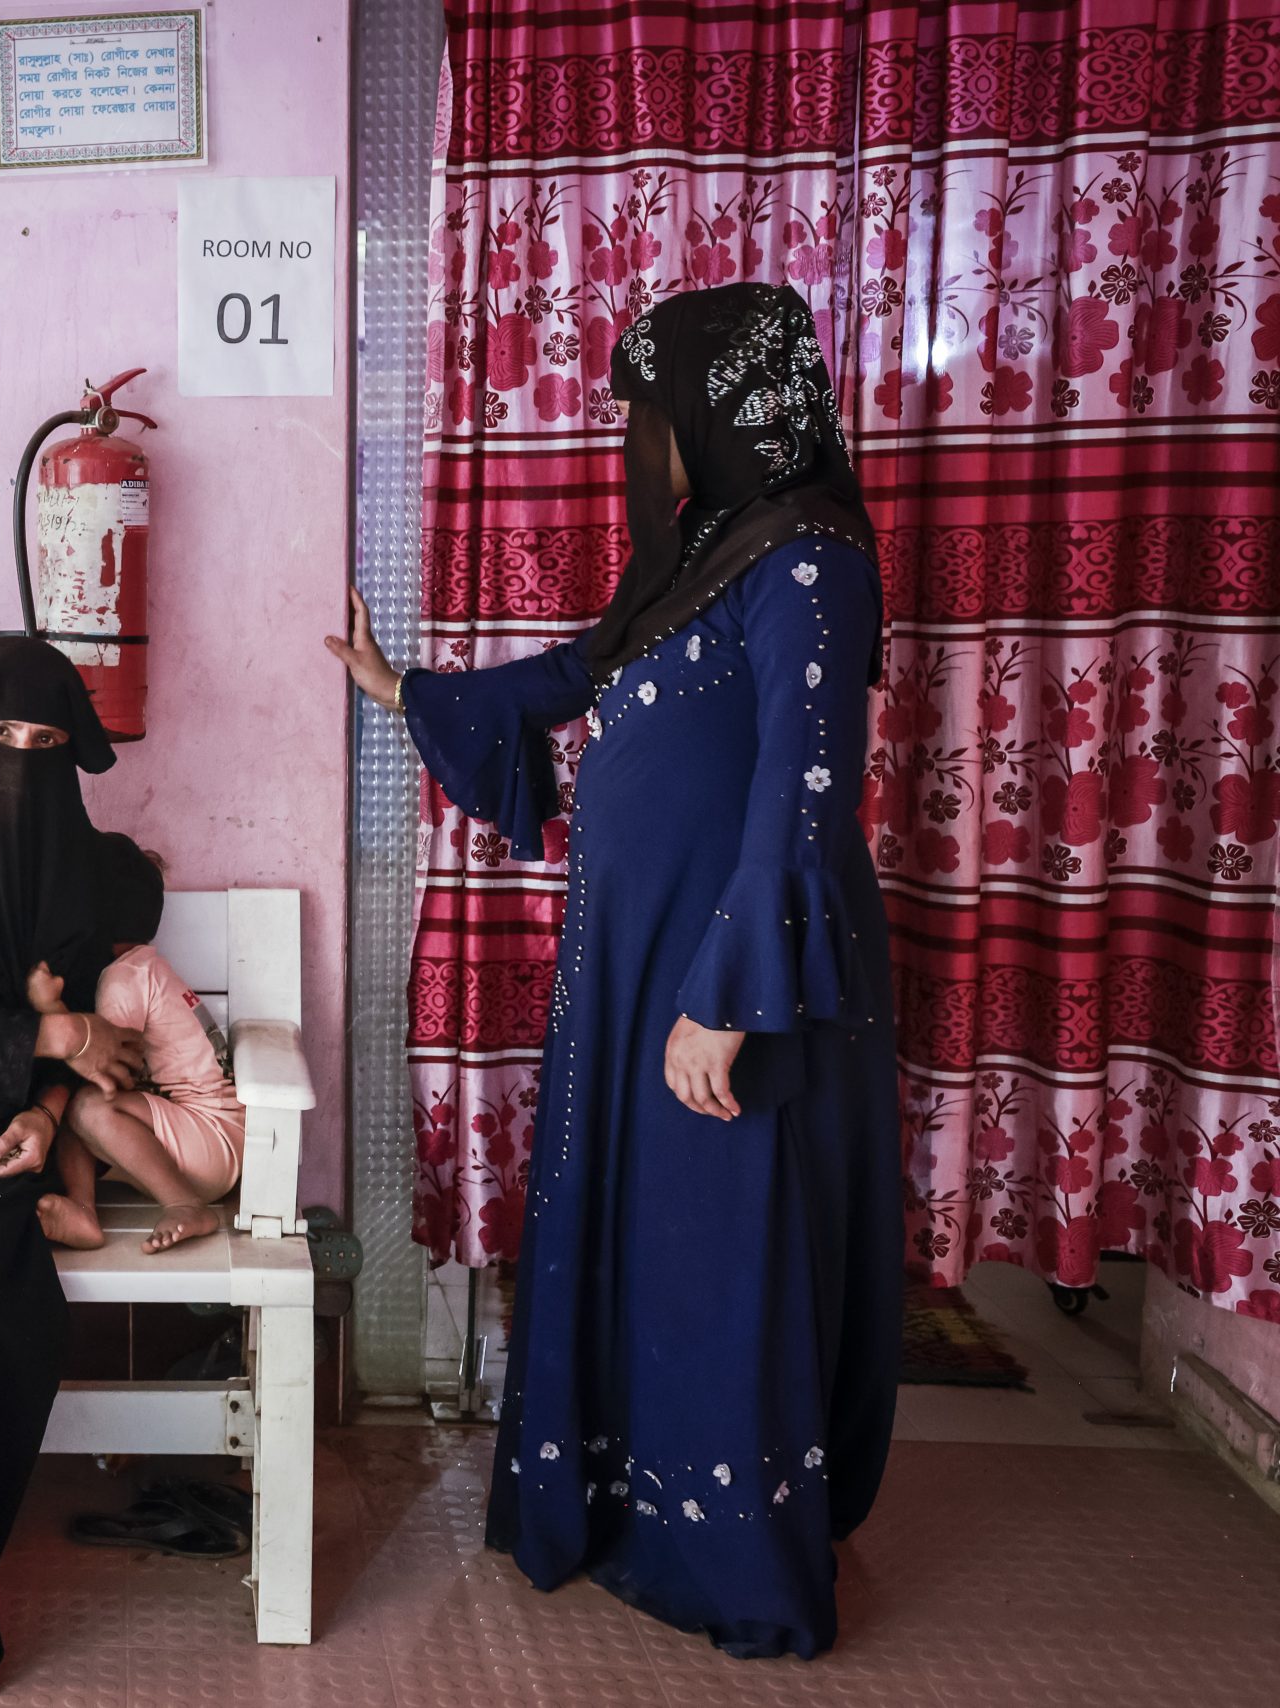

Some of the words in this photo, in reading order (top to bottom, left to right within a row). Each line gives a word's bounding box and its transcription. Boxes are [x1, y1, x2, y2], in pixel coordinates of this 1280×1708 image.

[101, 47, 139, 61] রোগীকে
[146, 47, 175, 59] দেখার
[19, 73, 40, 83] সময়
[47, 66, 77, 82] রোগীর
[85, 67, 110, 80] নিকট
[117, 66, 147, 77] নিজের
[155, 67, 174, 75] জন্য
[19, 90, 44, 101] দোয়া
[53, 89, 81, 98] করতে
[144, 84, 175, 94] কেননা
[20, 102, 50, 119] রোগীর
[59, 106, 84, 116] দোয়া
[144, 101, 176, 112] দোয়ার
[203, 240, 270, 258] ROOM
[280, 241, 311, 258] NO
[217, 293, 288, 344] 01
